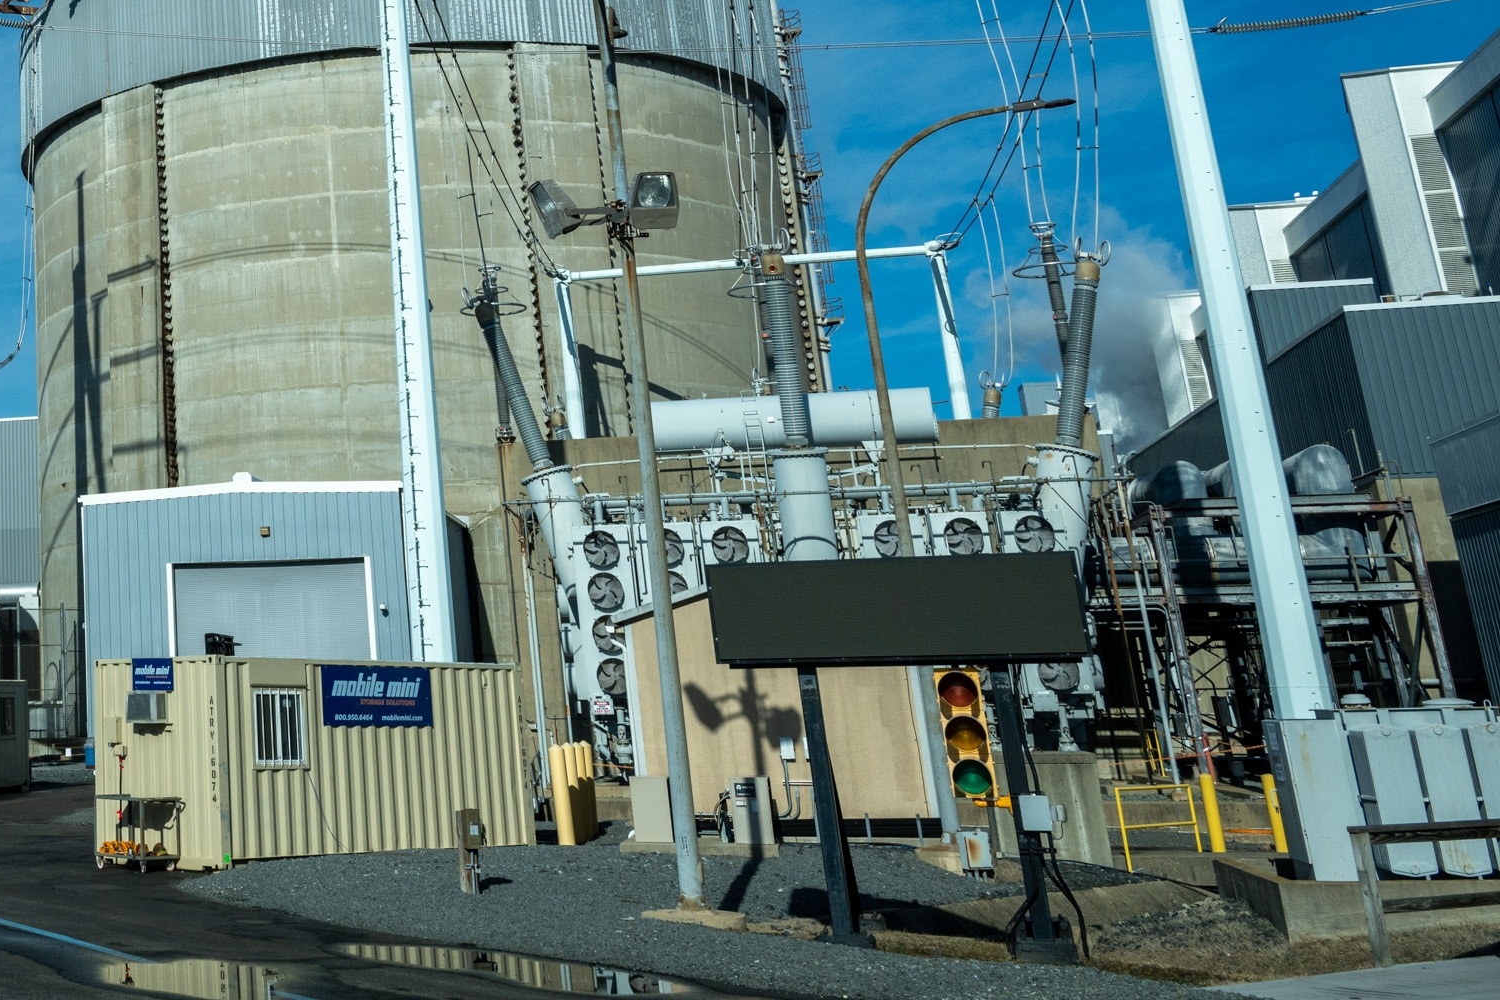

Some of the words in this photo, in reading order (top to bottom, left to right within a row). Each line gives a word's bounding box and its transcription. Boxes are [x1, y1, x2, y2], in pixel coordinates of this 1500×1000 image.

[134, 664, 155, 675] mobile
[331, 673, 384, 697] mobile
[386, 677, 421, 697] mini
[334, 713, 373, 721] 800.950.6464
